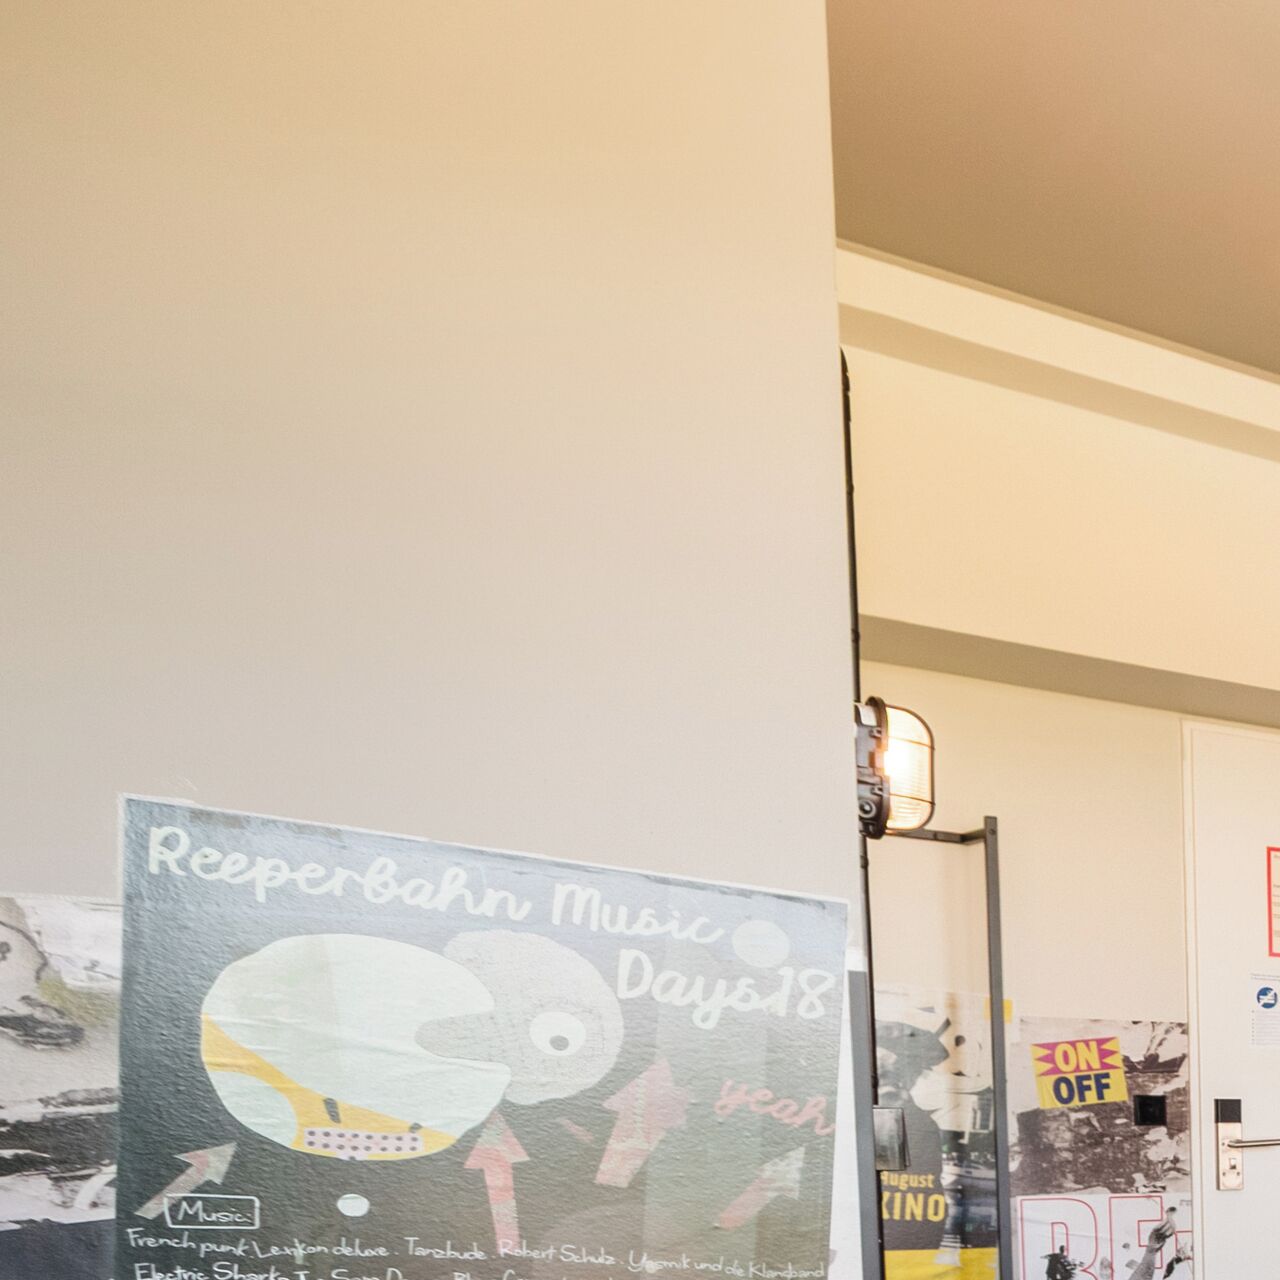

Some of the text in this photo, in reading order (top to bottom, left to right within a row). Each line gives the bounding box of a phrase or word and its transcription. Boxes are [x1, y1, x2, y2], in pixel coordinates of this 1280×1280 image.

[149, 825, 724, 944] Reeperbahn Music
[1056, 1040, 1101, 1073] ON
[715, 1077, 833, 1136] yeah
[1052, 1074, 1112, 1105] OFF
[126, 1228, 196, 1249] French
[500, 1240, 556, 1260] Robert
[694, 1256, 724, 1272] und
[725, 1260, 747, 1277] die
